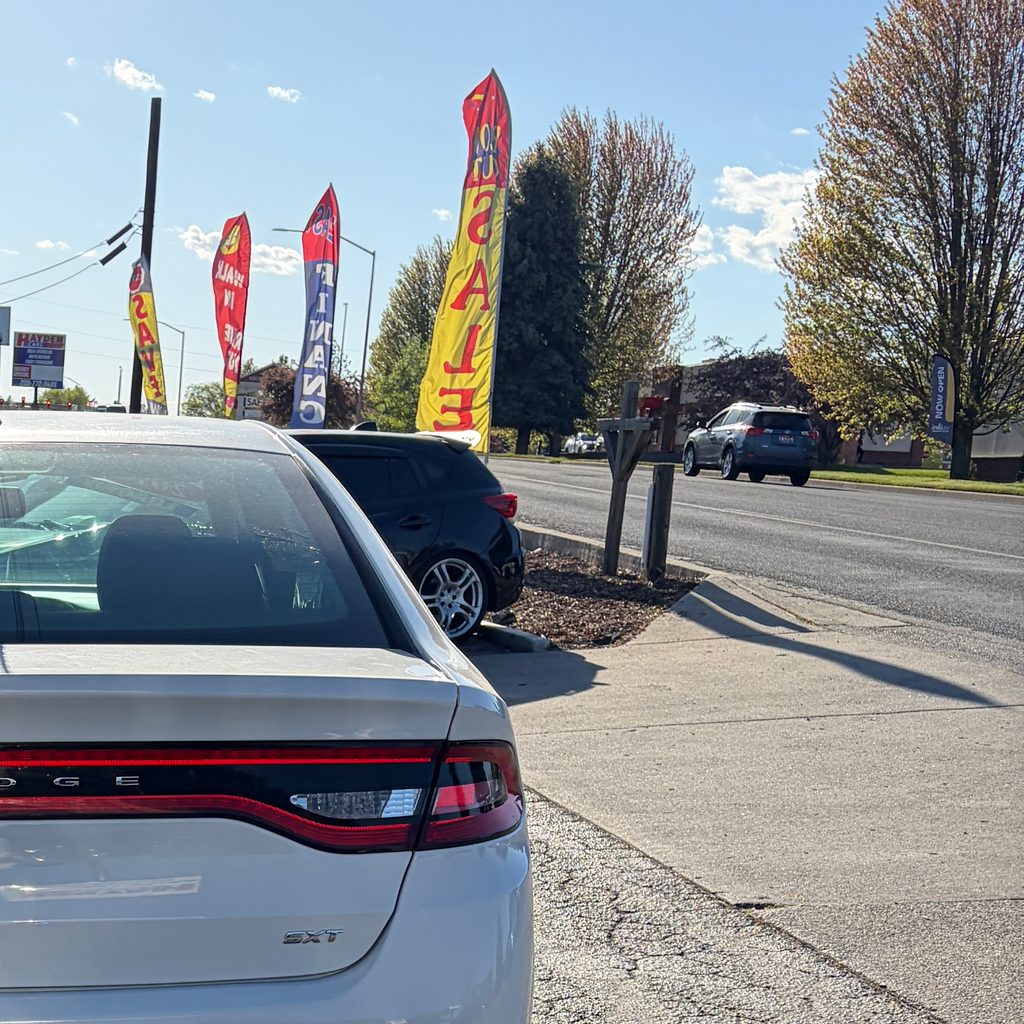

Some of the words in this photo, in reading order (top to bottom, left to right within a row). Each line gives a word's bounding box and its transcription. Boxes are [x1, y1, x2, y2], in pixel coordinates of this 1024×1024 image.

[937, 366, 945, 393] OPEN
[935, 395, 943, 419] NOW
[283, 928, 344, 944] SXT
